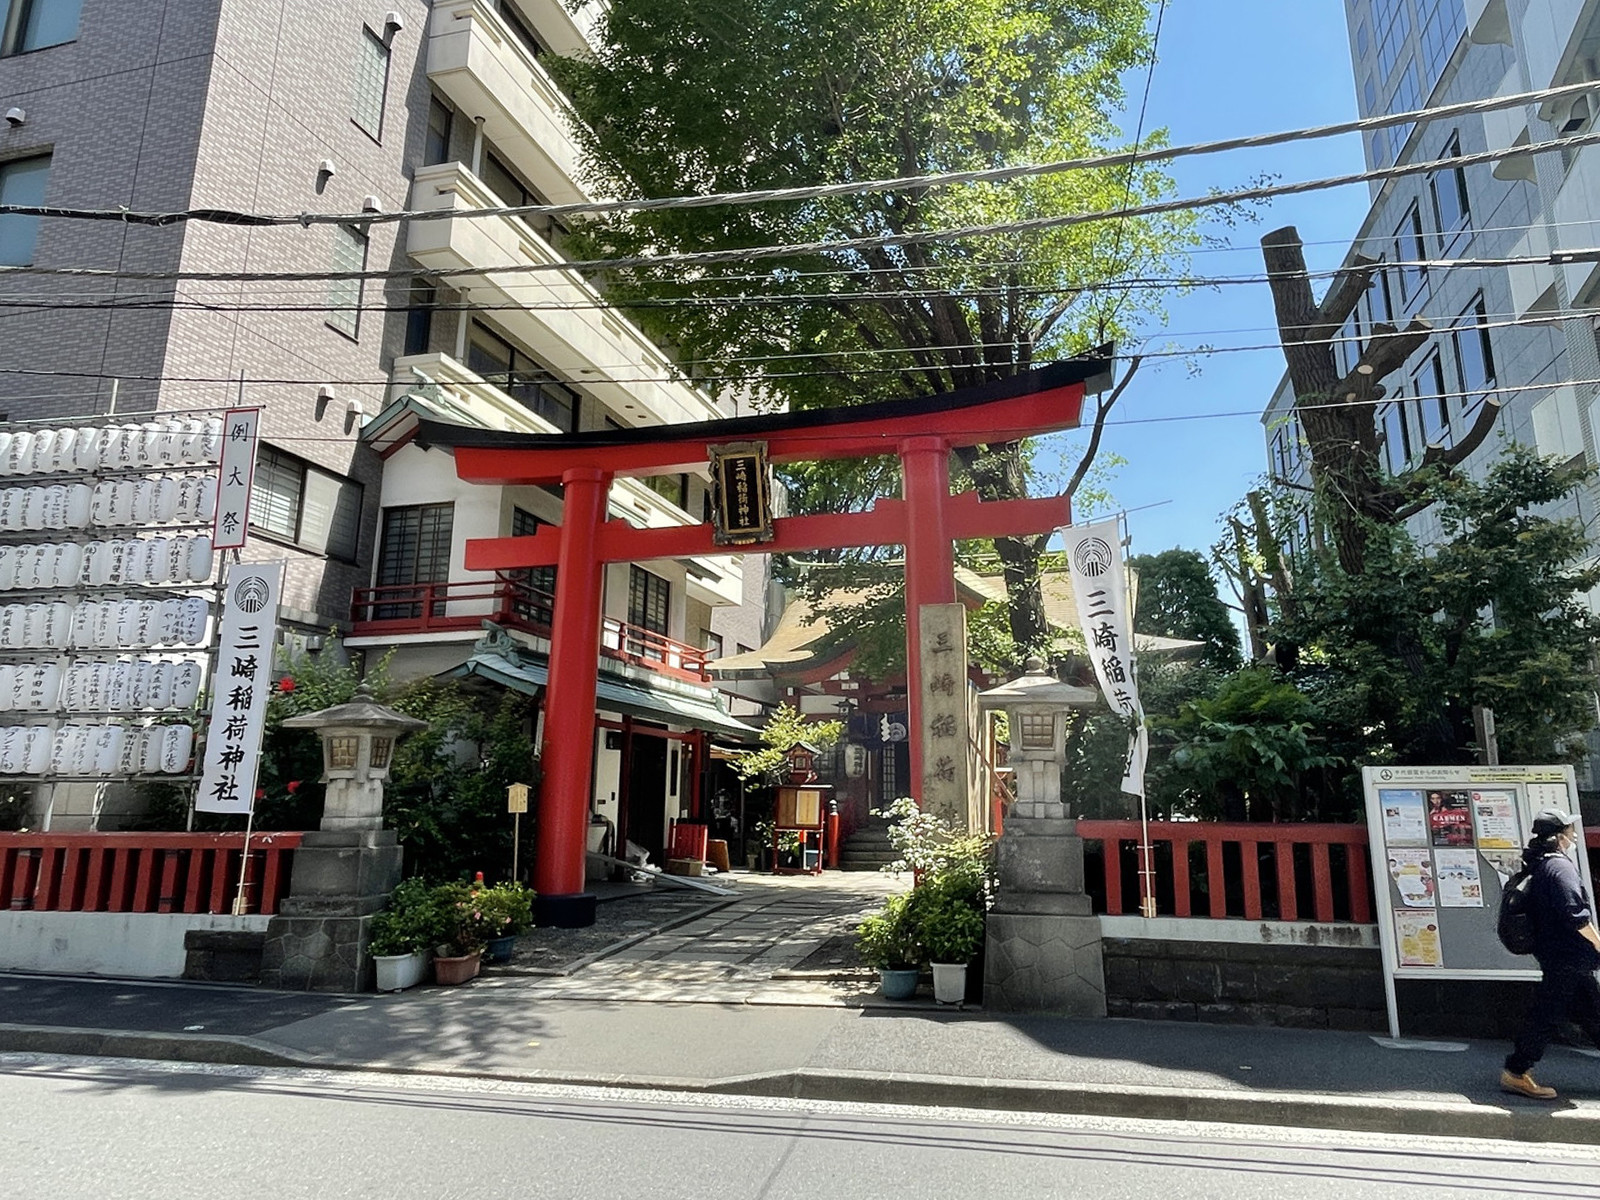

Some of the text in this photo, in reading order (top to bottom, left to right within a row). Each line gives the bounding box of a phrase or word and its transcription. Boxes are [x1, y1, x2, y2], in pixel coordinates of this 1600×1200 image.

[221, 422, 249, 536] 例大祭
[735, 459, 750, 527] 三崎稲荷神社
[209, 625, 261, 802] 三崎稲荷神社
